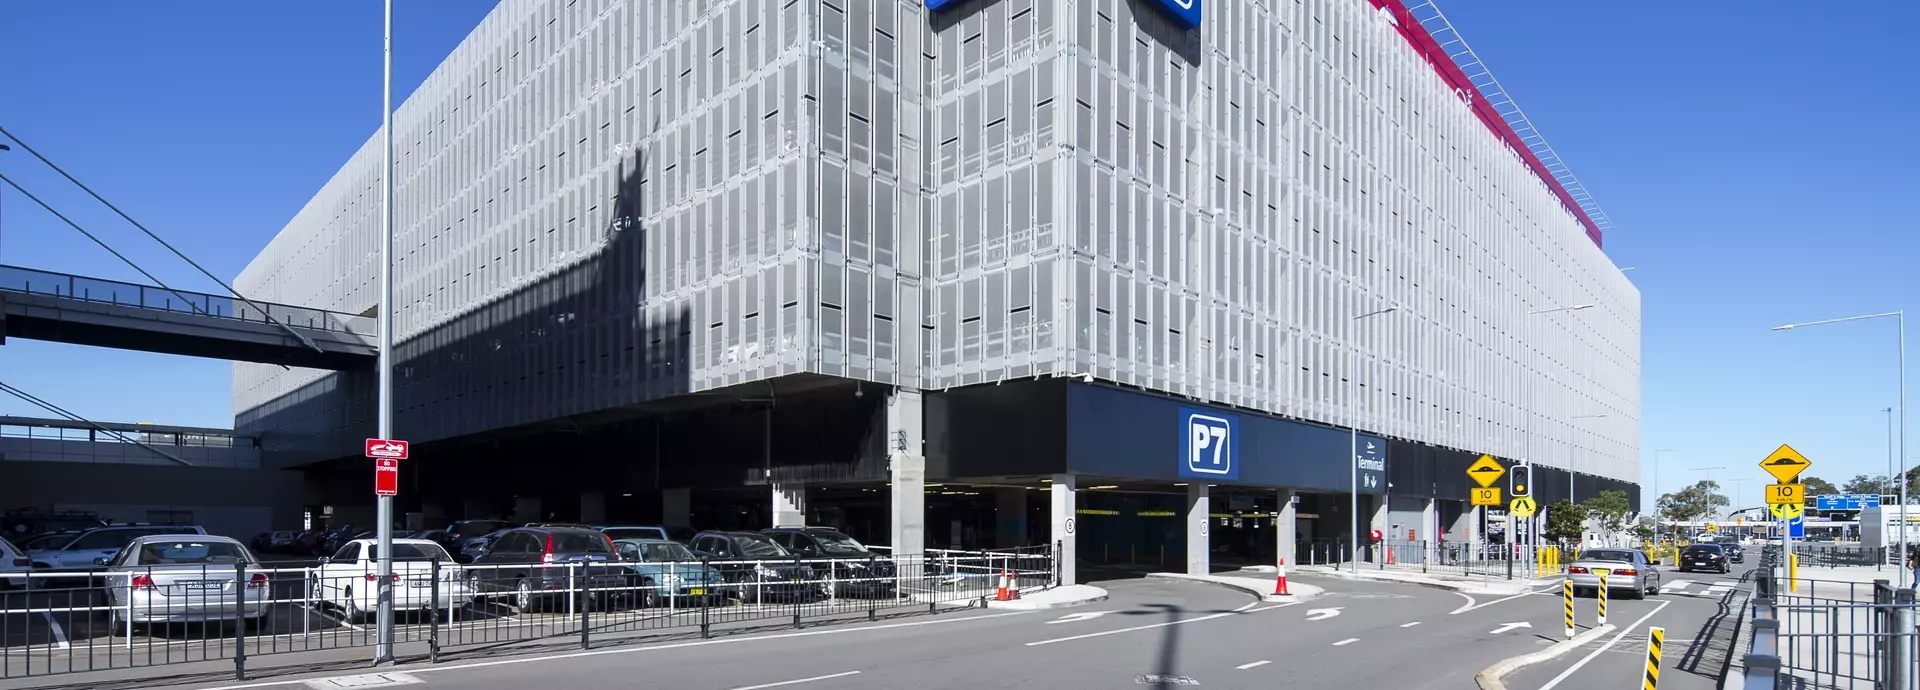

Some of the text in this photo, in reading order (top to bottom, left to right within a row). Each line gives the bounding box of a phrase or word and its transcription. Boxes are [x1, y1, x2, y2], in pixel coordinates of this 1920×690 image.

[1192, 423, 1227, 465] P7
[1357, 455, 1385, 471] Terminal
[1480, 490, 1492, 499] 10
[1776, 486, 1793, 497] 10
